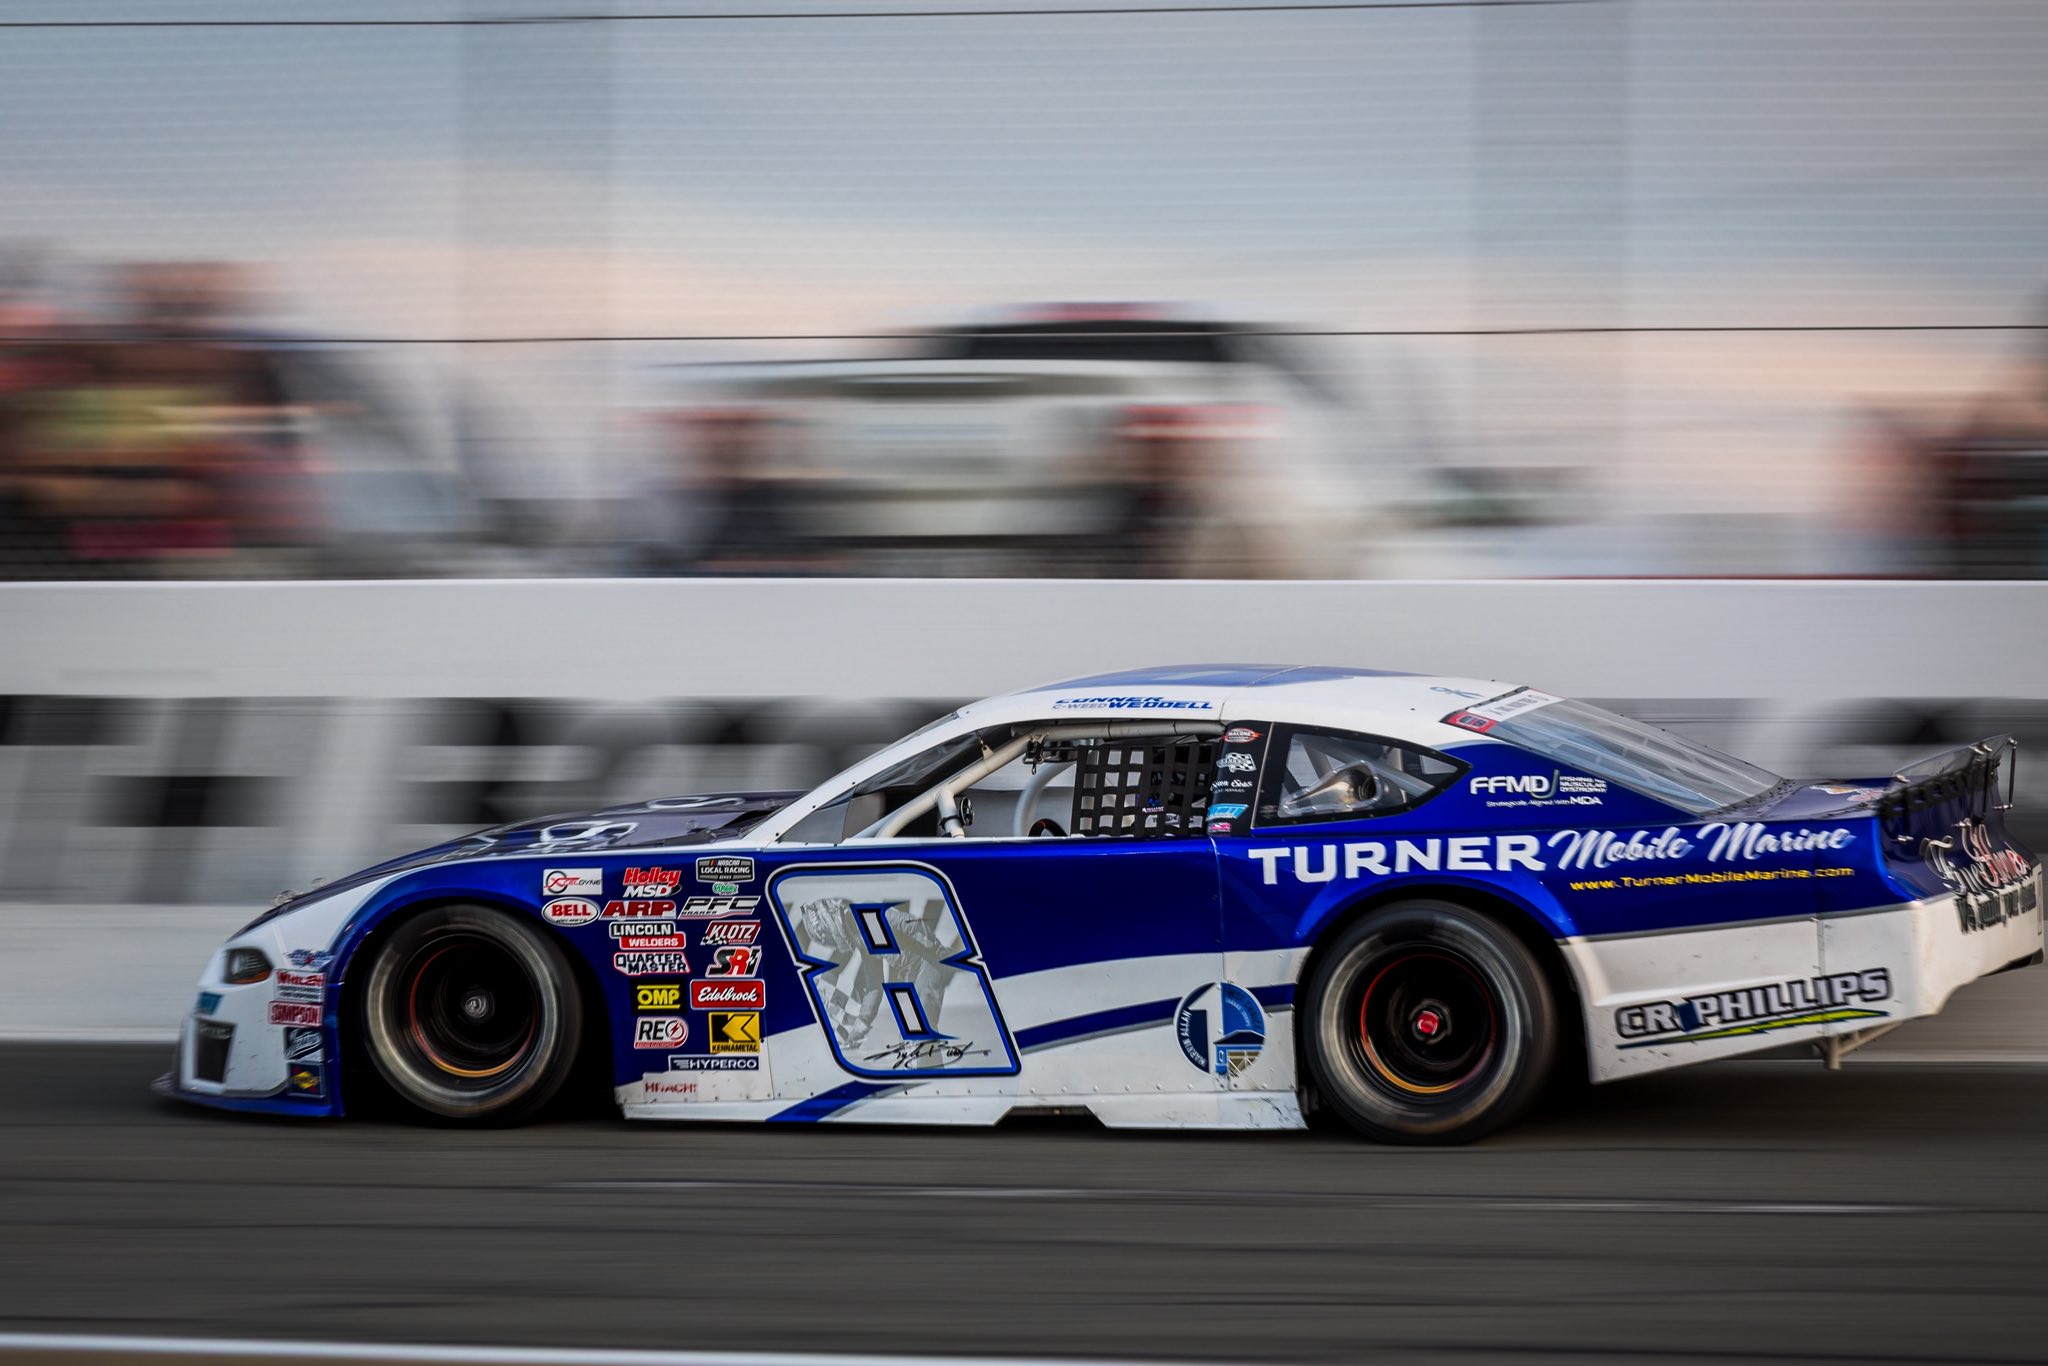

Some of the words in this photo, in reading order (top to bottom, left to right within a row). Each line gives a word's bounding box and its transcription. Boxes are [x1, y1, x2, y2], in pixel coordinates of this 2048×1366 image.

[1108, 701, 1213, 710] WEDDELL
[1470, 775, 1550, 795] FFMD
[1247, 834, 1547, 885] TURNER
[1546, 825, 1696, 871] Mobile
[1695, 821, 1858, 863] Marine
[622, 867, 681, 887] Holley
[700, 866, 724, 874] LOCAL
[724, 866, 750, 874] RACING
[1570, 866, 1855, 891] www.TurnerMobileMarine.com
[622, 884, 673, 898] MSD
[551, 903, 592, 917] BELL
[601, 901, 676, 917] ARP
[683, 896, 760, 910] PFC
[612, 923, 672, 937] LINCOLN
[706, 924, 757, 940] KLOTZ
[628, 937, 679, 948] WELDERS
[615, 953, 684, 968] QUARTER
[627, 962, 687, 974] MASTER
[764, 859, 1022, 1081] 8
[637, 989, 680, 1006] OMP
[698, 986, 758, 1003] Edelbrock
[1692, 967, 1891, 1025] PHILLIPS
[270, 1003, 321, 1024] SIMPSON
[711, 1044, 758, 1053] KENNAMETAL
[689, 1059, 758, 1070] HYPERCO
